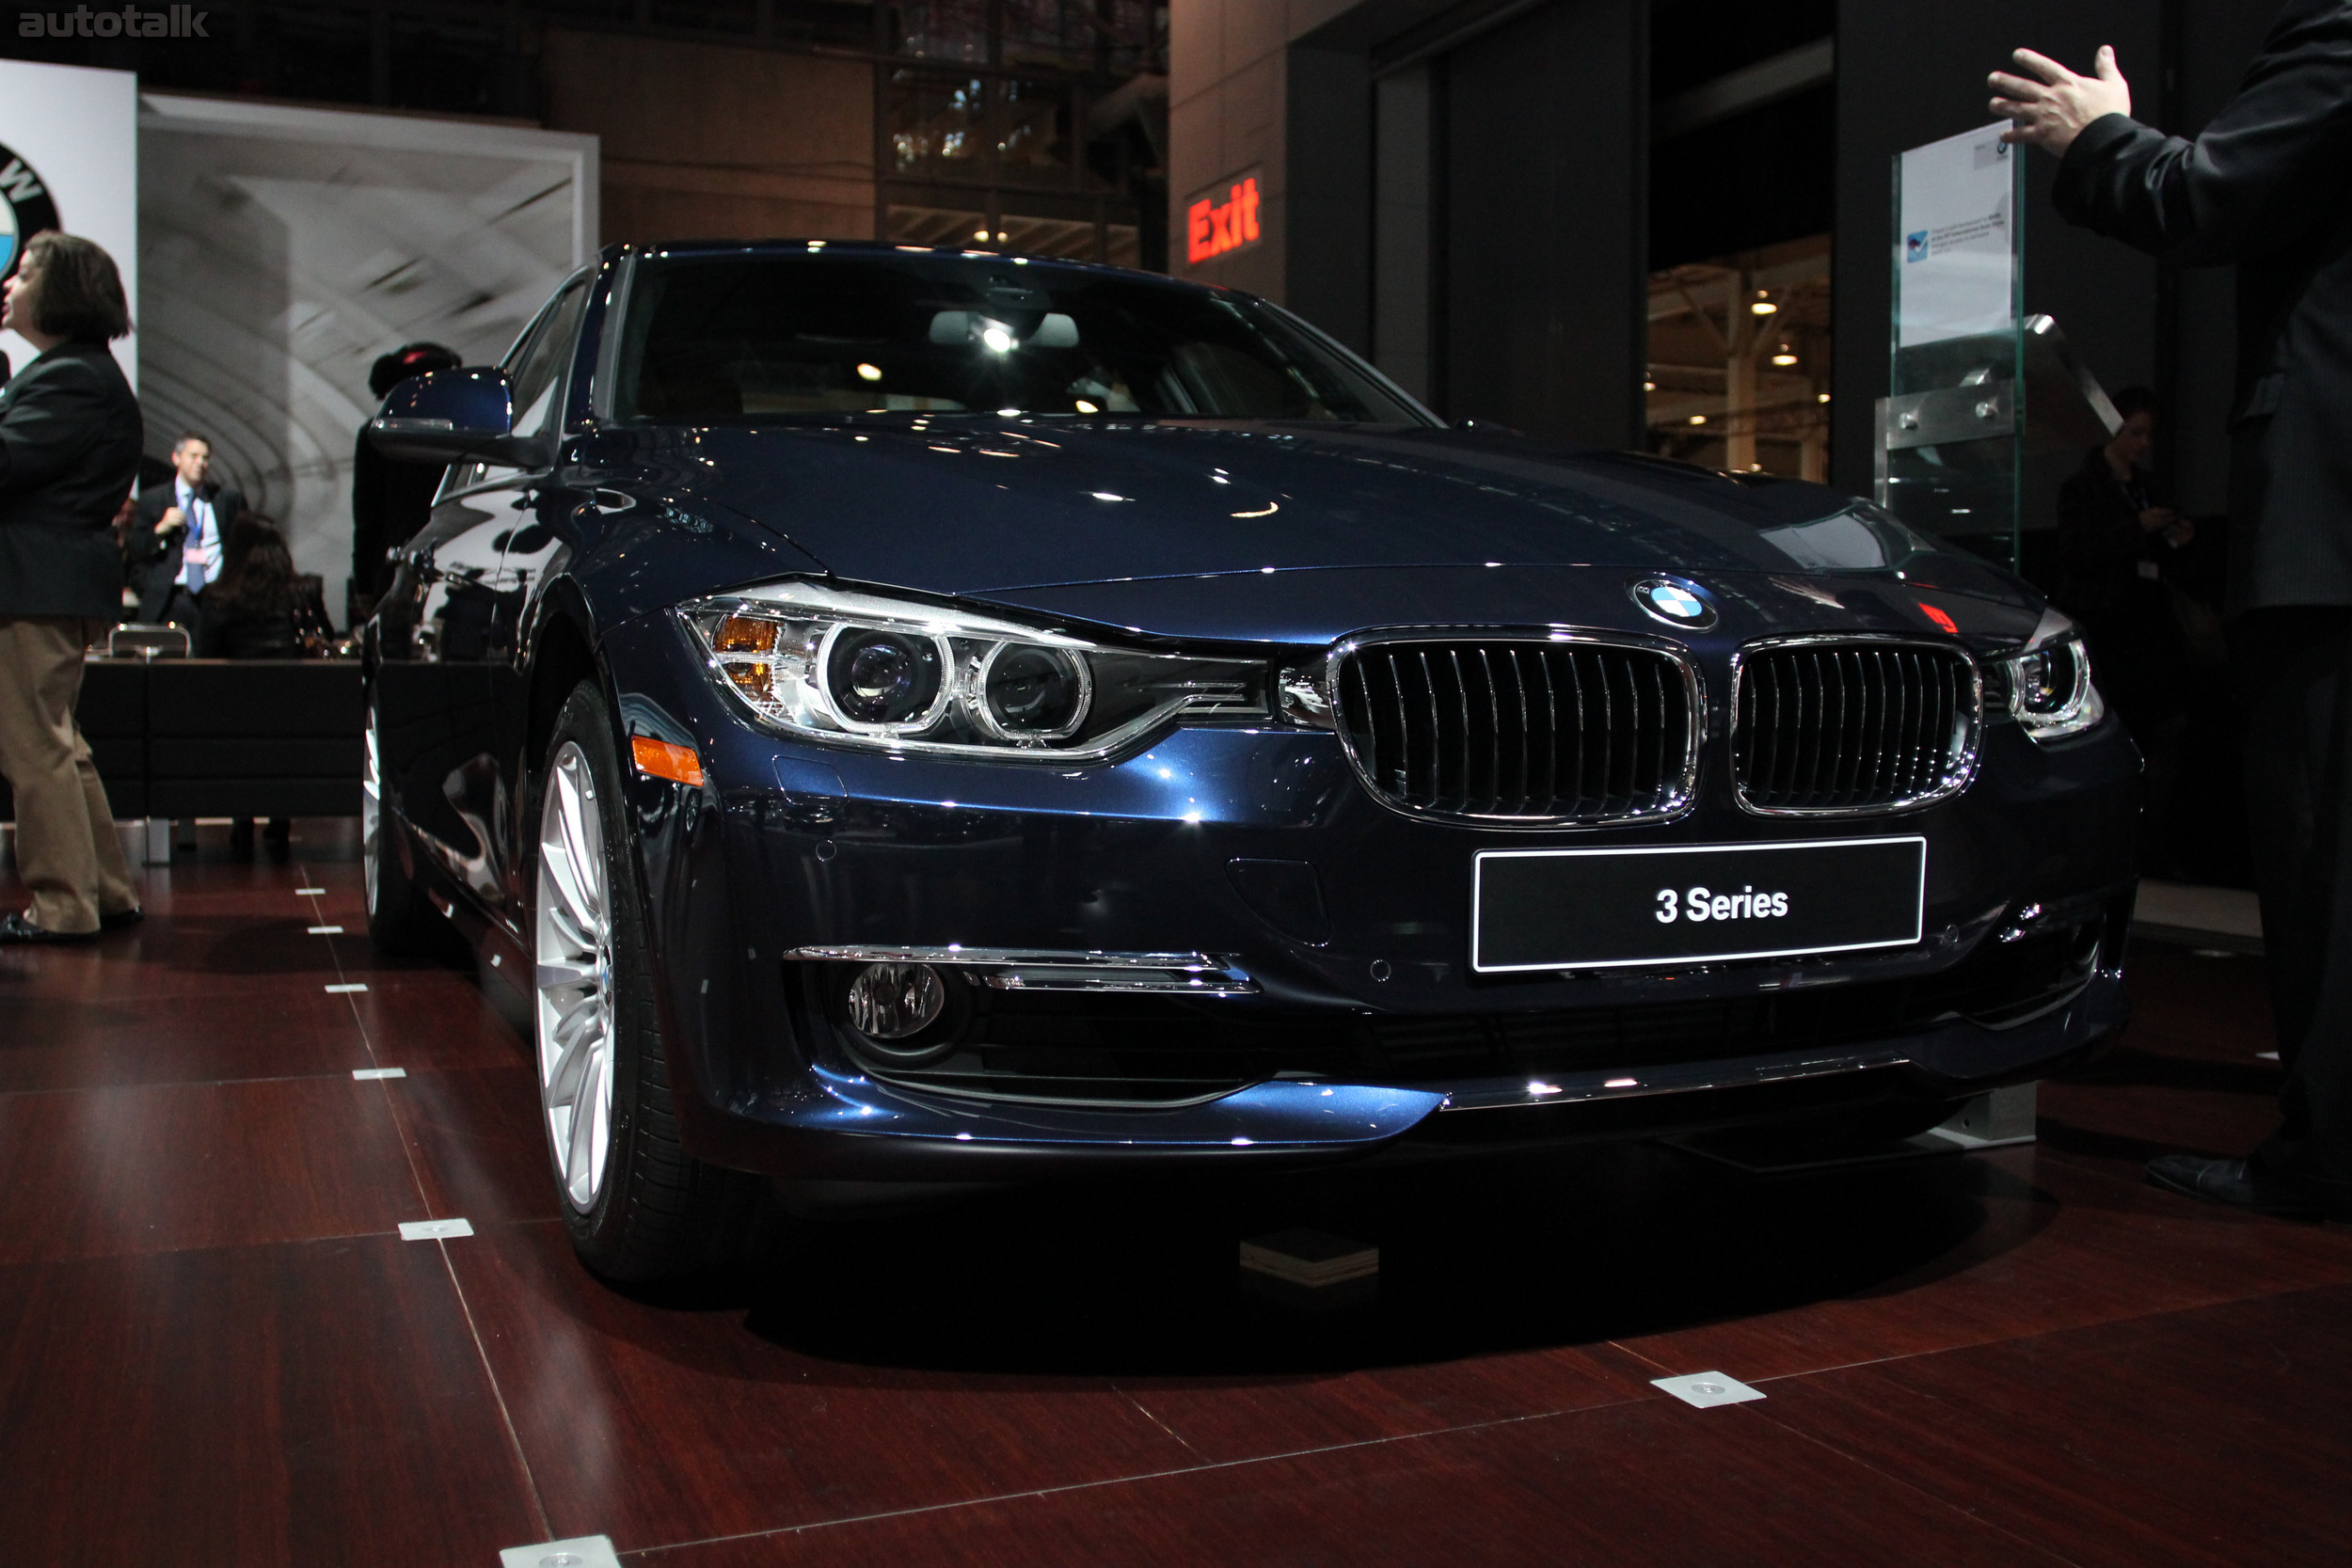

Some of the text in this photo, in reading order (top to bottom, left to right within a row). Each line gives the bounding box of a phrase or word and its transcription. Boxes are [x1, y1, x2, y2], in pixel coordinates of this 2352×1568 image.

[1188, 177, 1260, 263] Exit
[1656, 885, 1788, 924] 3 Series
